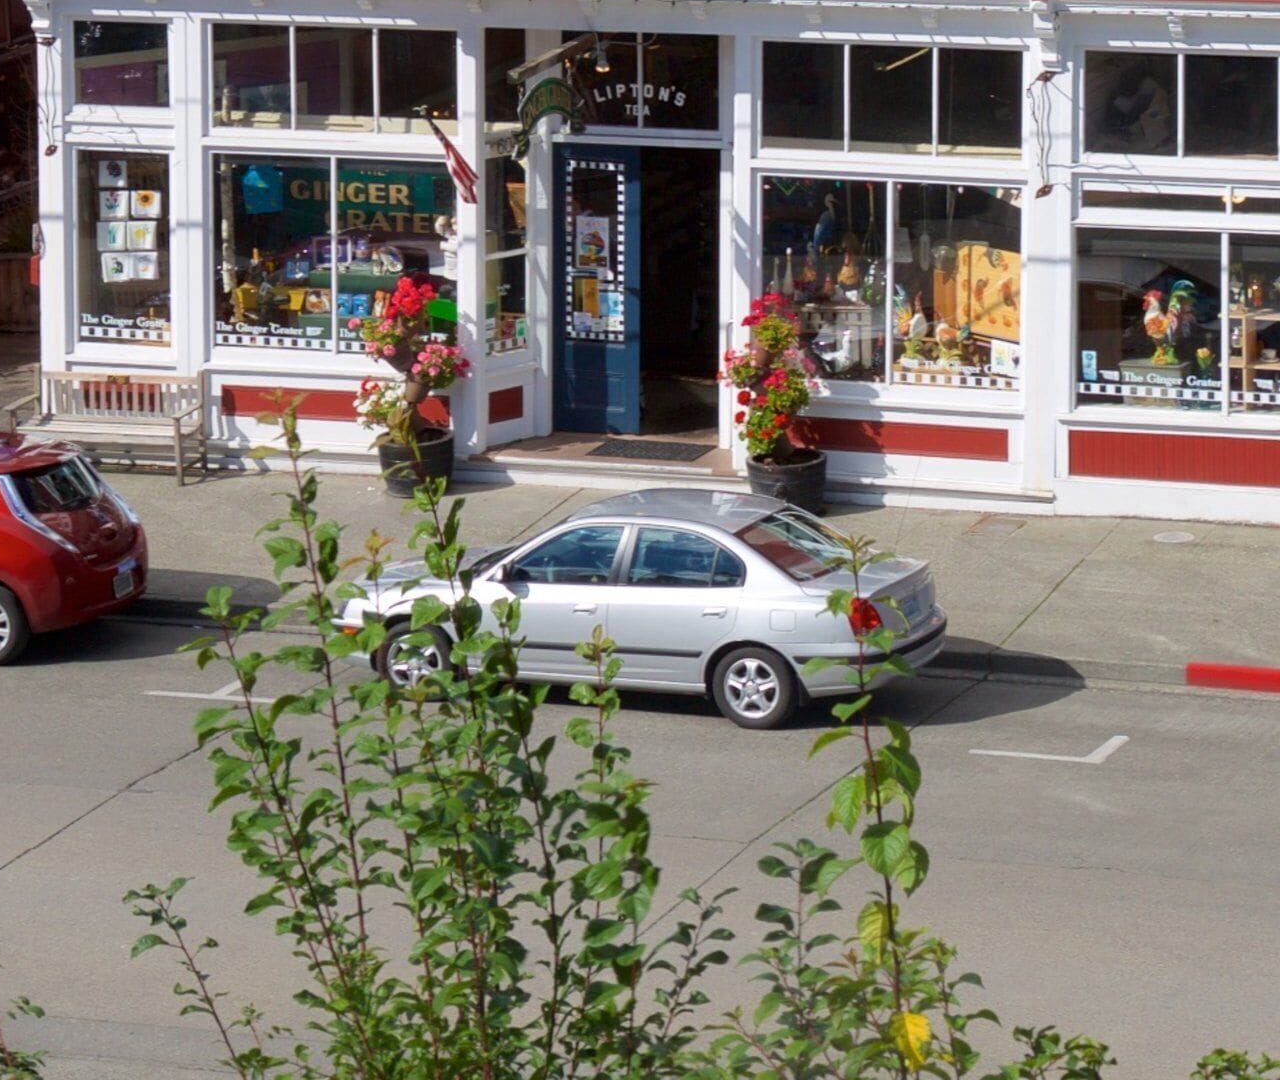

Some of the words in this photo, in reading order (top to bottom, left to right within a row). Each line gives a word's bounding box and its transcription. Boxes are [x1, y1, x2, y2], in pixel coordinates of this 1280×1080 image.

[593, 83, 687, 107] LIPTON'S
[624, 104, 651, 116] TEA
[290, 179, 412, 206] GINGER
[81, 313, 99, 324] The
[101, 315, 135, 328] Ginger
[216, 321, 233, 332] The
[235, 322, 268, 334] Ginger
[270, 324, 303, 335] Grater
[339, 328, 357, 338] The
[1124, 371, 1142, 383] The
[1146, 372, 1183, 388] Ginger
[1186, 375, 1222, 387] Grater
